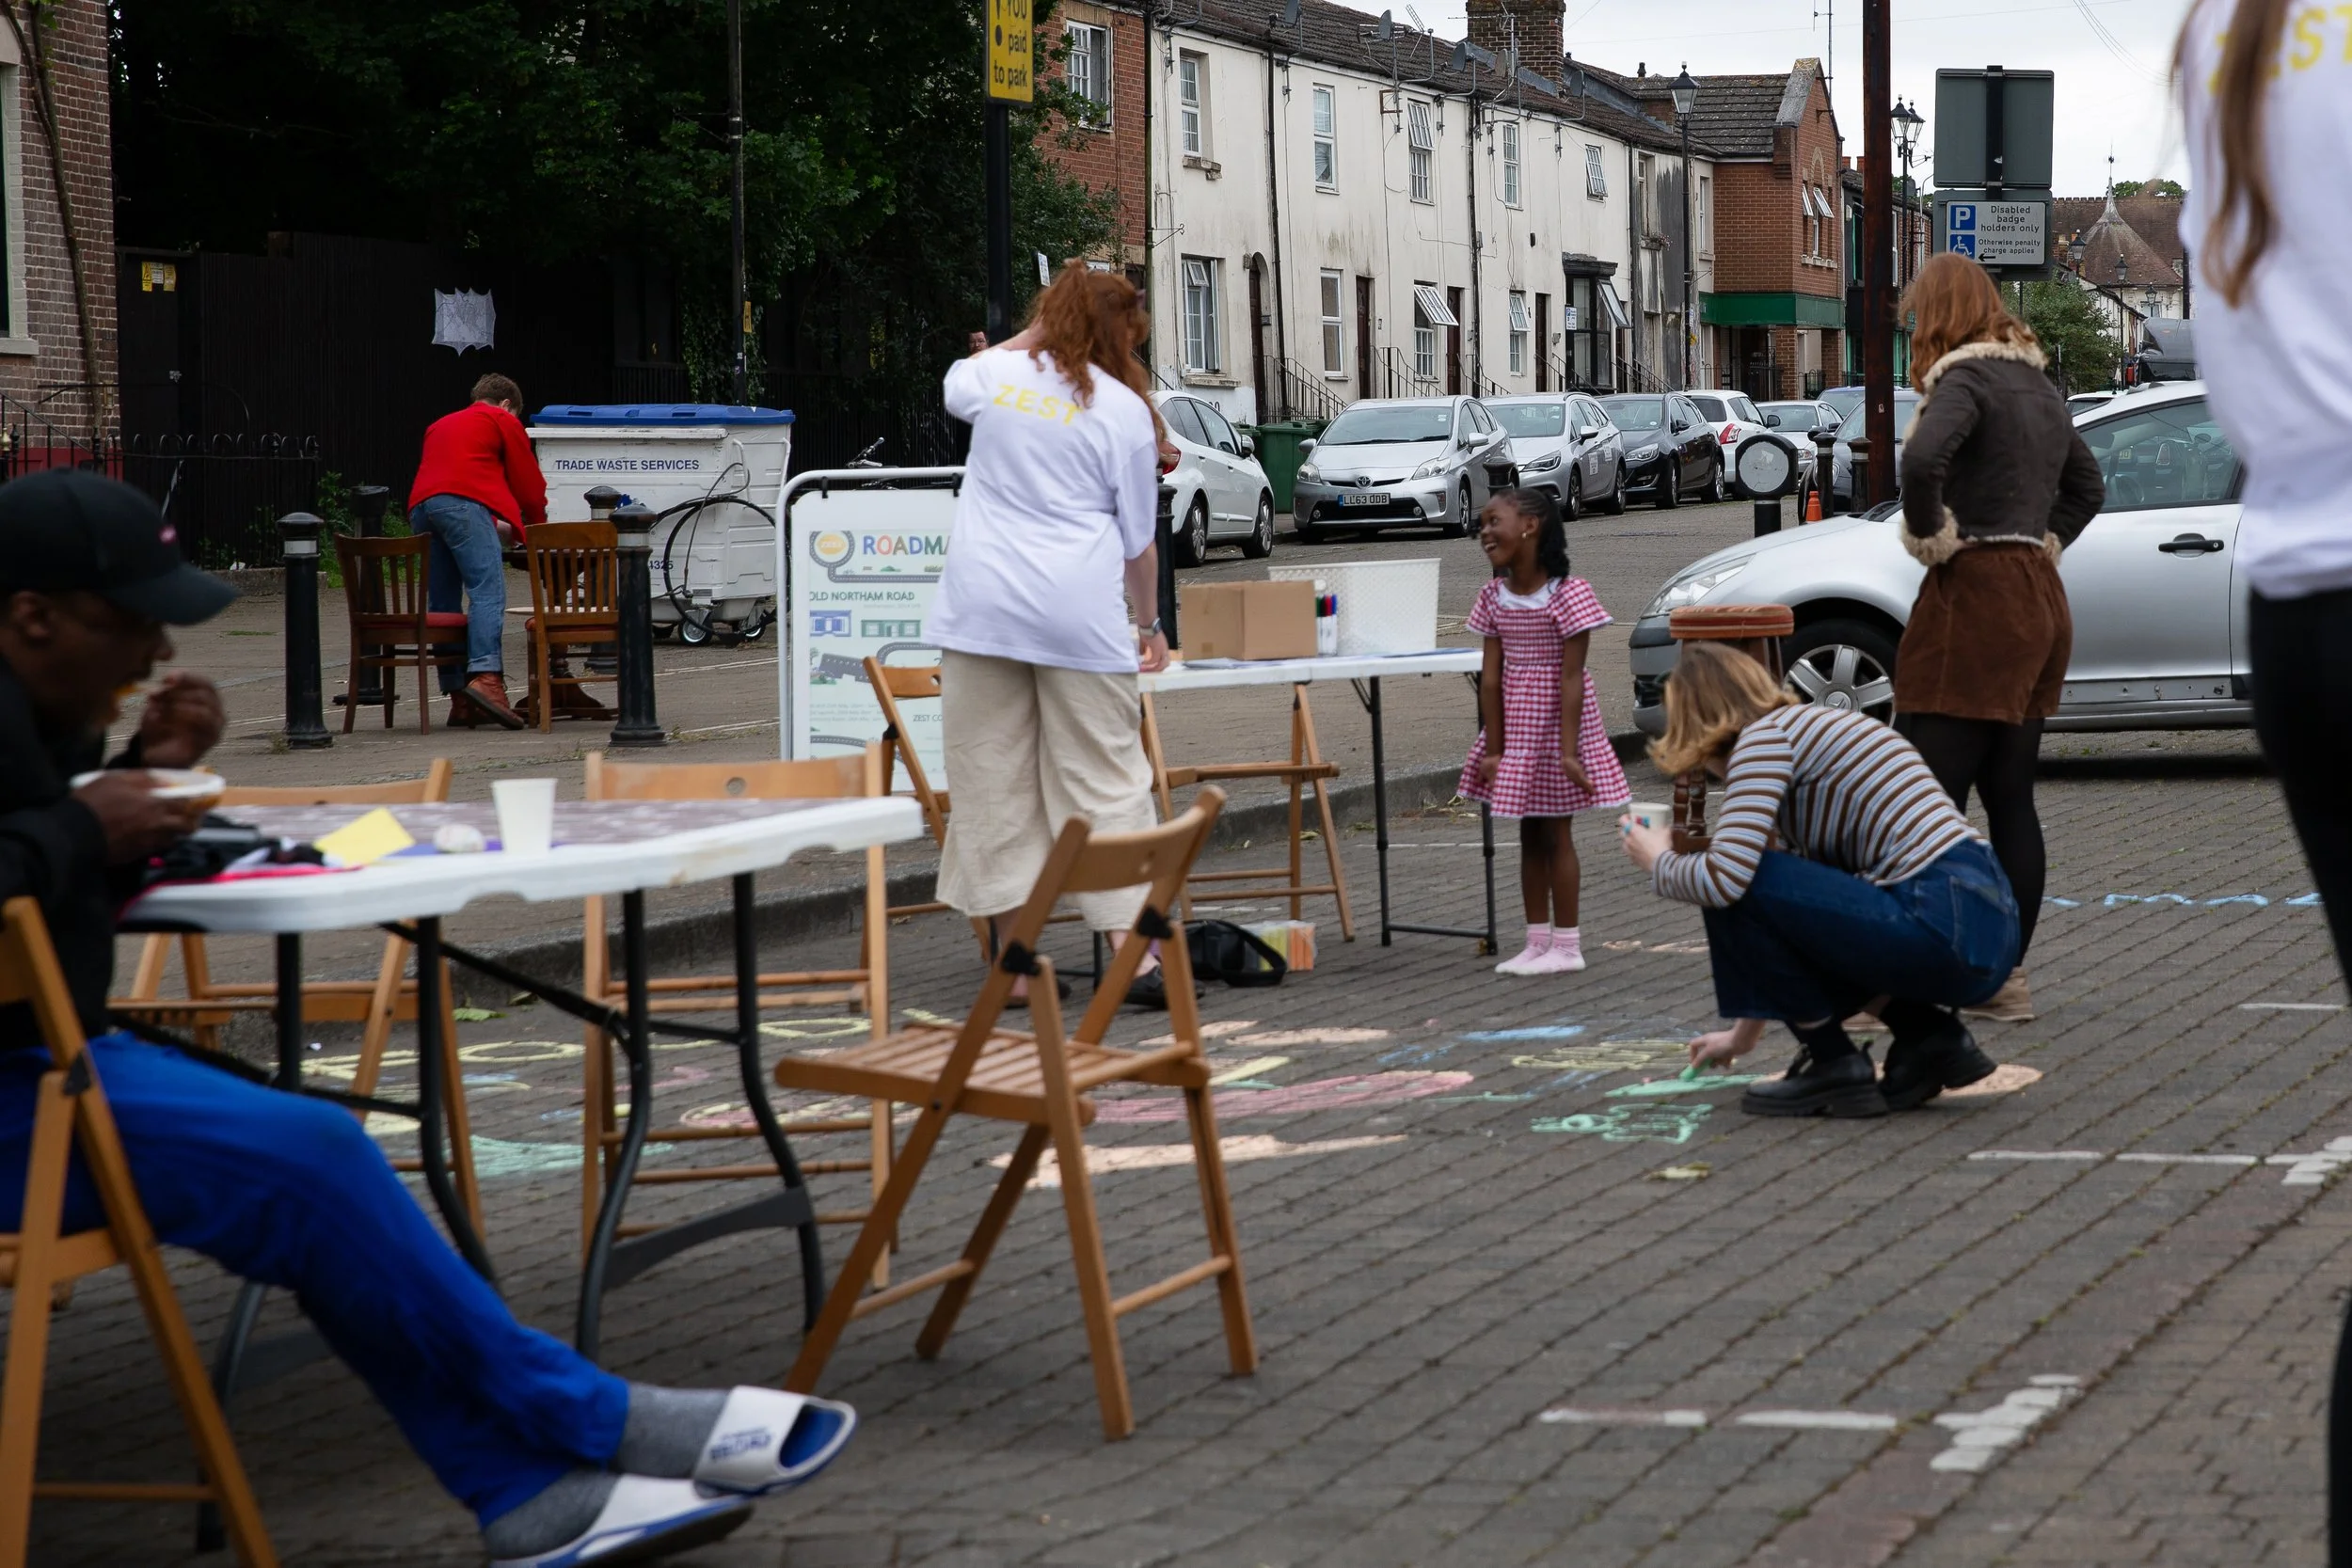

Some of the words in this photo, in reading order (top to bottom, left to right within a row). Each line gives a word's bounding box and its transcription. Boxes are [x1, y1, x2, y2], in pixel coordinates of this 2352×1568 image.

[1009, 30, 1027, 55] paid
[993, 59, 1005, 84] to
[1009, 63, 1027, 89] park
[1991, 205, 2031, 214] Disabled
[1956, 207, 1971, 228] P
[1996, 215, 2026, 224] badge
[2019, 224, 2040, 233] only
[2014, 238, 2041, 246] penalty
[993, 385, 1083, 425] ZEST
[555, 460, 594, 470] TRADE
[596, 460, 638, 470] WASTE
[641, 460, 700, 470] SERVICES
[1343, 495, 1367, 505] LL63
[809, 591, 828, 601] OLD
[831, 591, 883, 601] NORTHAM
[886, 591, 915, 601] ROAD
